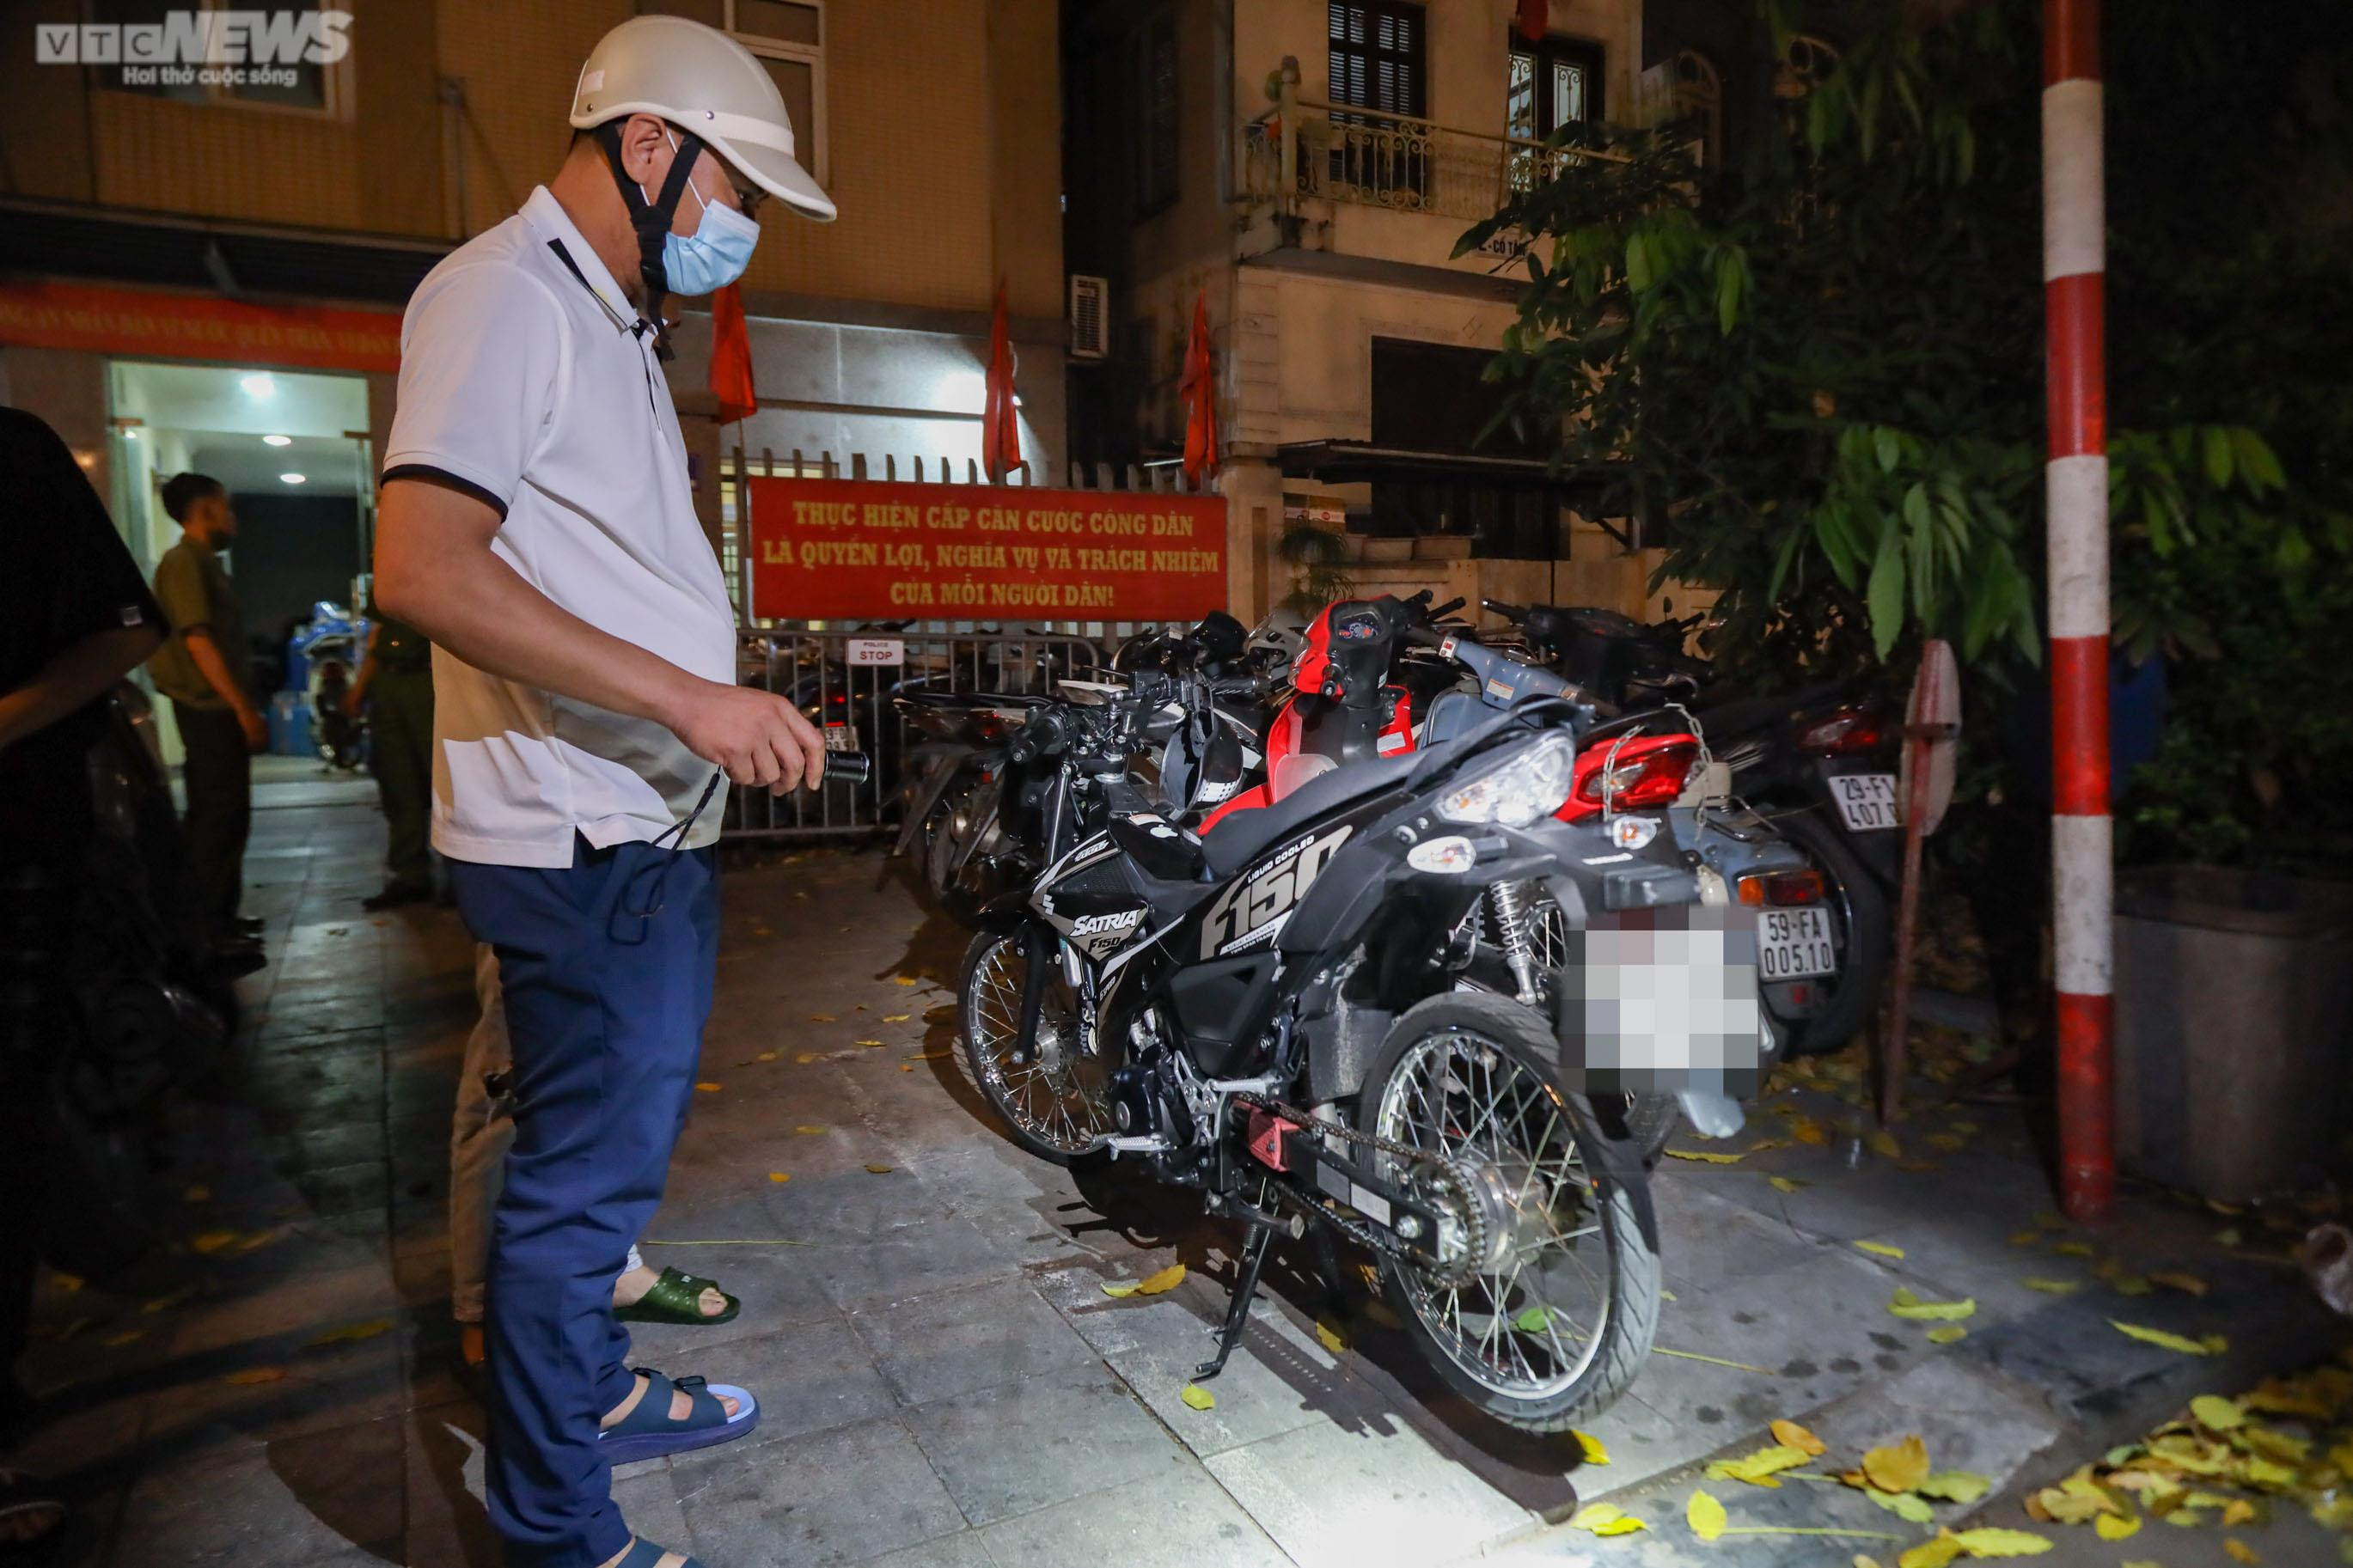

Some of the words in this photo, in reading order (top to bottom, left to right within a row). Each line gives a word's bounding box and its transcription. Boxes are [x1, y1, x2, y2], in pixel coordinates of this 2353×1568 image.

[862, 499, 920, 533] HIỆN
[1089, 509, 1146, 535] CÔNG
[1152, 509, 1195, 537] DÂN
[1011, 546, 1039, 574] VỤ
[1044, 543, 1073, 570] VÀ
[1077, 544, 1146, 571] TRÁCH
[1152, 546, 1219, 577] NHIỆM
[1065, 580, 1115, 607] DÂN!
[859, 651, 892, 660] STOP
[1840, 777, 1896, 800] 29-F1
[1247, 859, 1274, 884] LIQUID
[1274, 834, 1315, 866] COOLED
[1069, 909, 1140, 937] SATRIA
[1767, 911, 1821, 941] 59-FA
[1088, 937, 1121, 952] F150
[1764, 943, 1830, 974] 005.10
